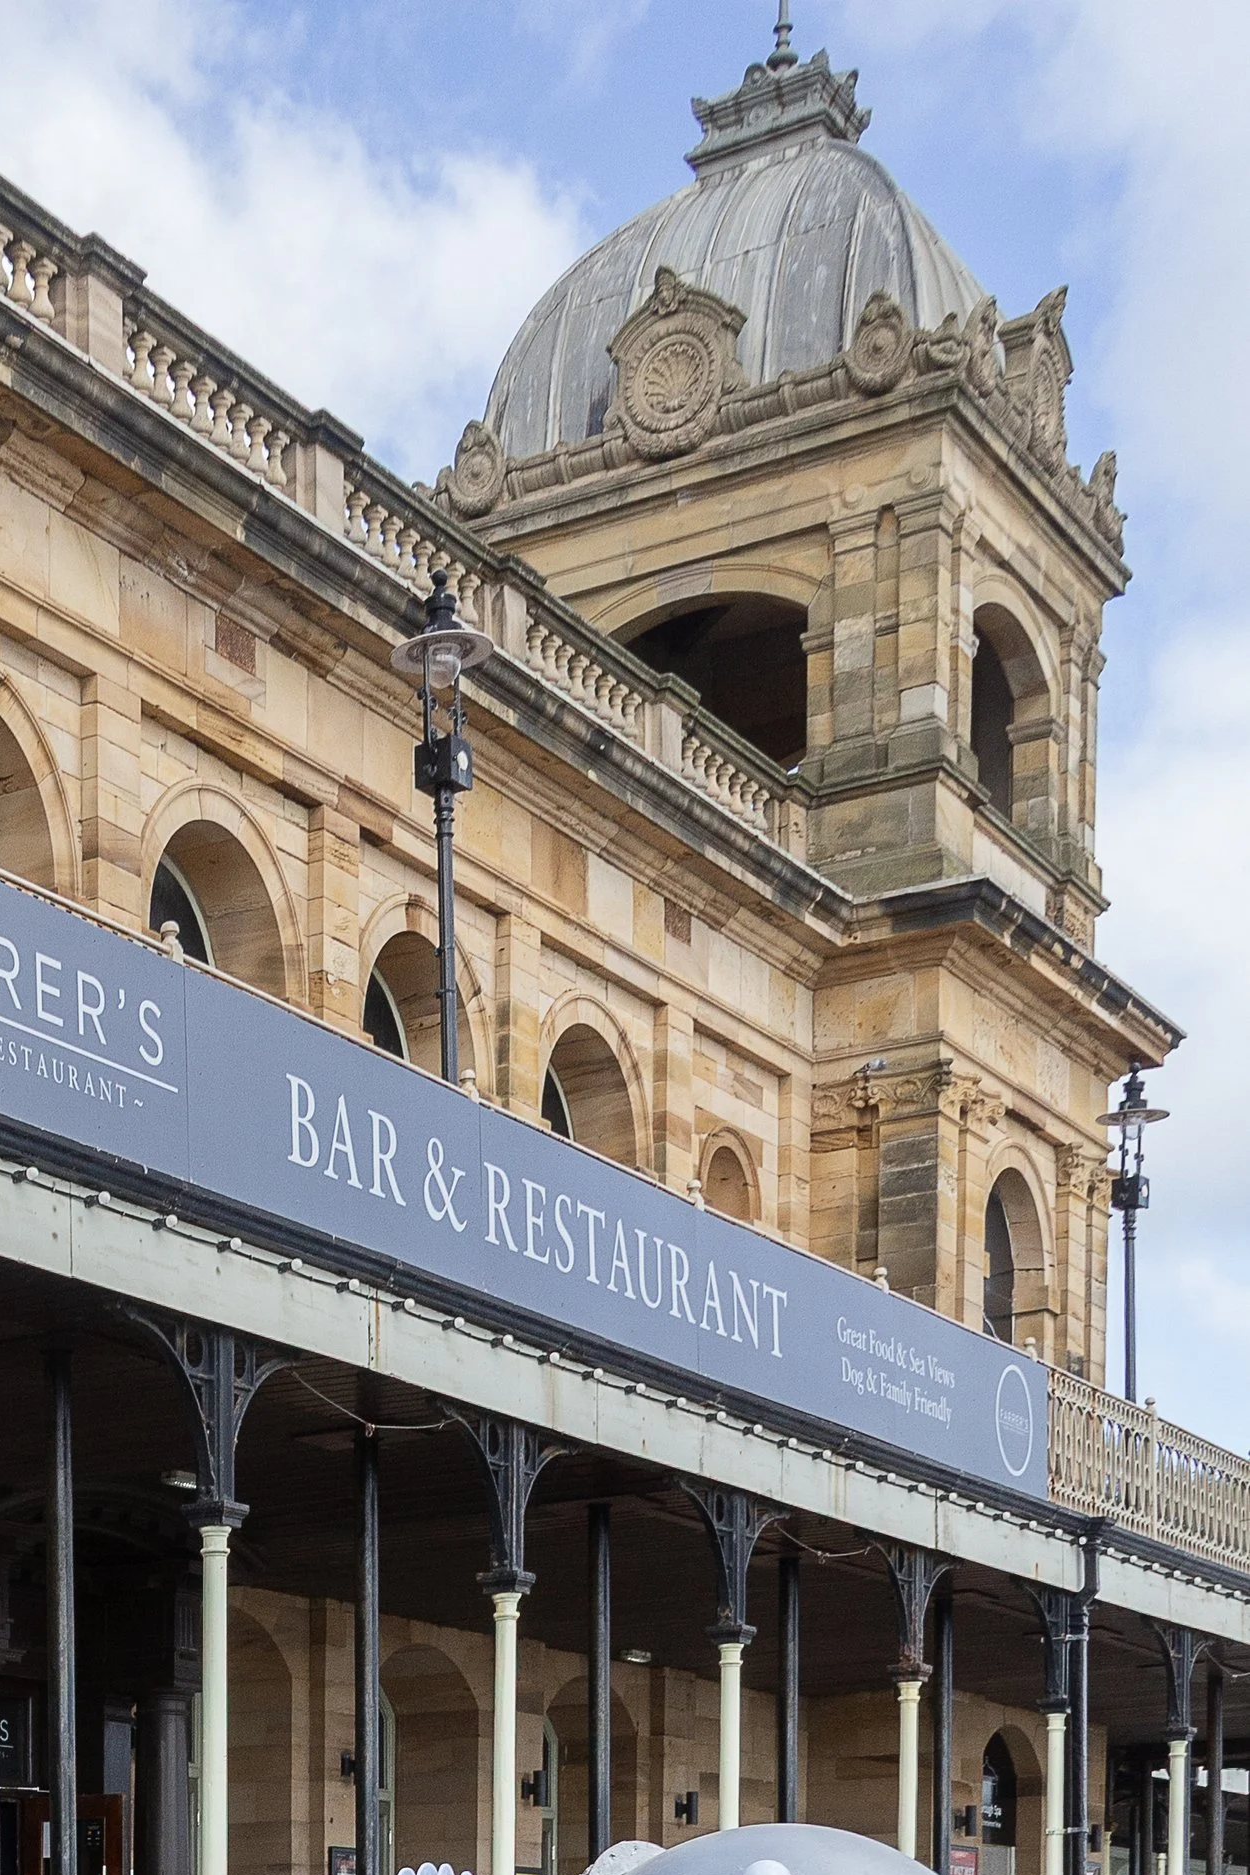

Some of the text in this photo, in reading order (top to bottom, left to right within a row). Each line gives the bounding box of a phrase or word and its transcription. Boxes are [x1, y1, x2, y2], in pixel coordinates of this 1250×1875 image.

[286, 1073, 788, 1358] BAR & RESTAURANT
[837, 1316, 956, 1389] Great Food & Sea Views
[841, 1356, 952, 1430] Dog & Family Friendly
